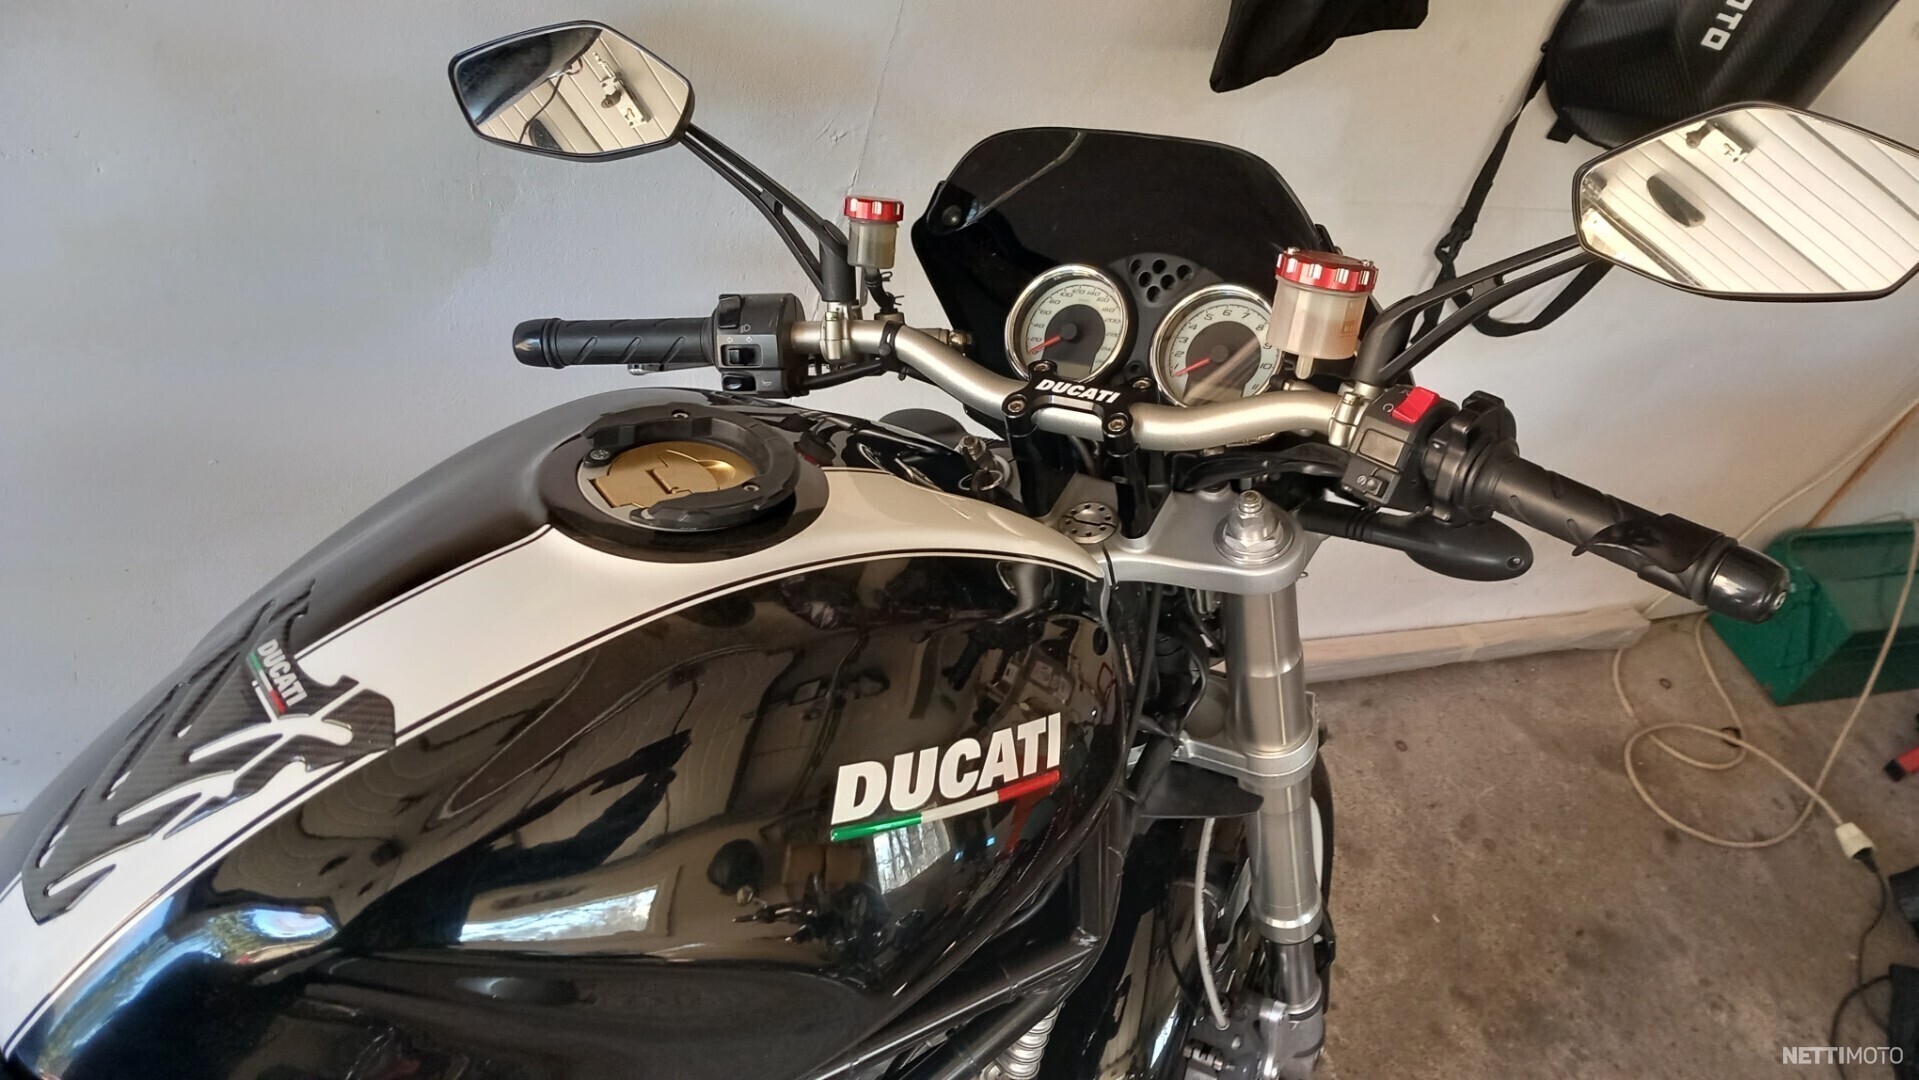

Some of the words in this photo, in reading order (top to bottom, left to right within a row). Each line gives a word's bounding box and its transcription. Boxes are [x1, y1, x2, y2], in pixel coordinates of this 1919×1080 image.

[1260, 362, 1272, 370] 10
[1035, 379, 1121, 404] DUCATI
[257, 638, 308, 707] DUCATI
[831, 712, 1061, 825] DUCATI
